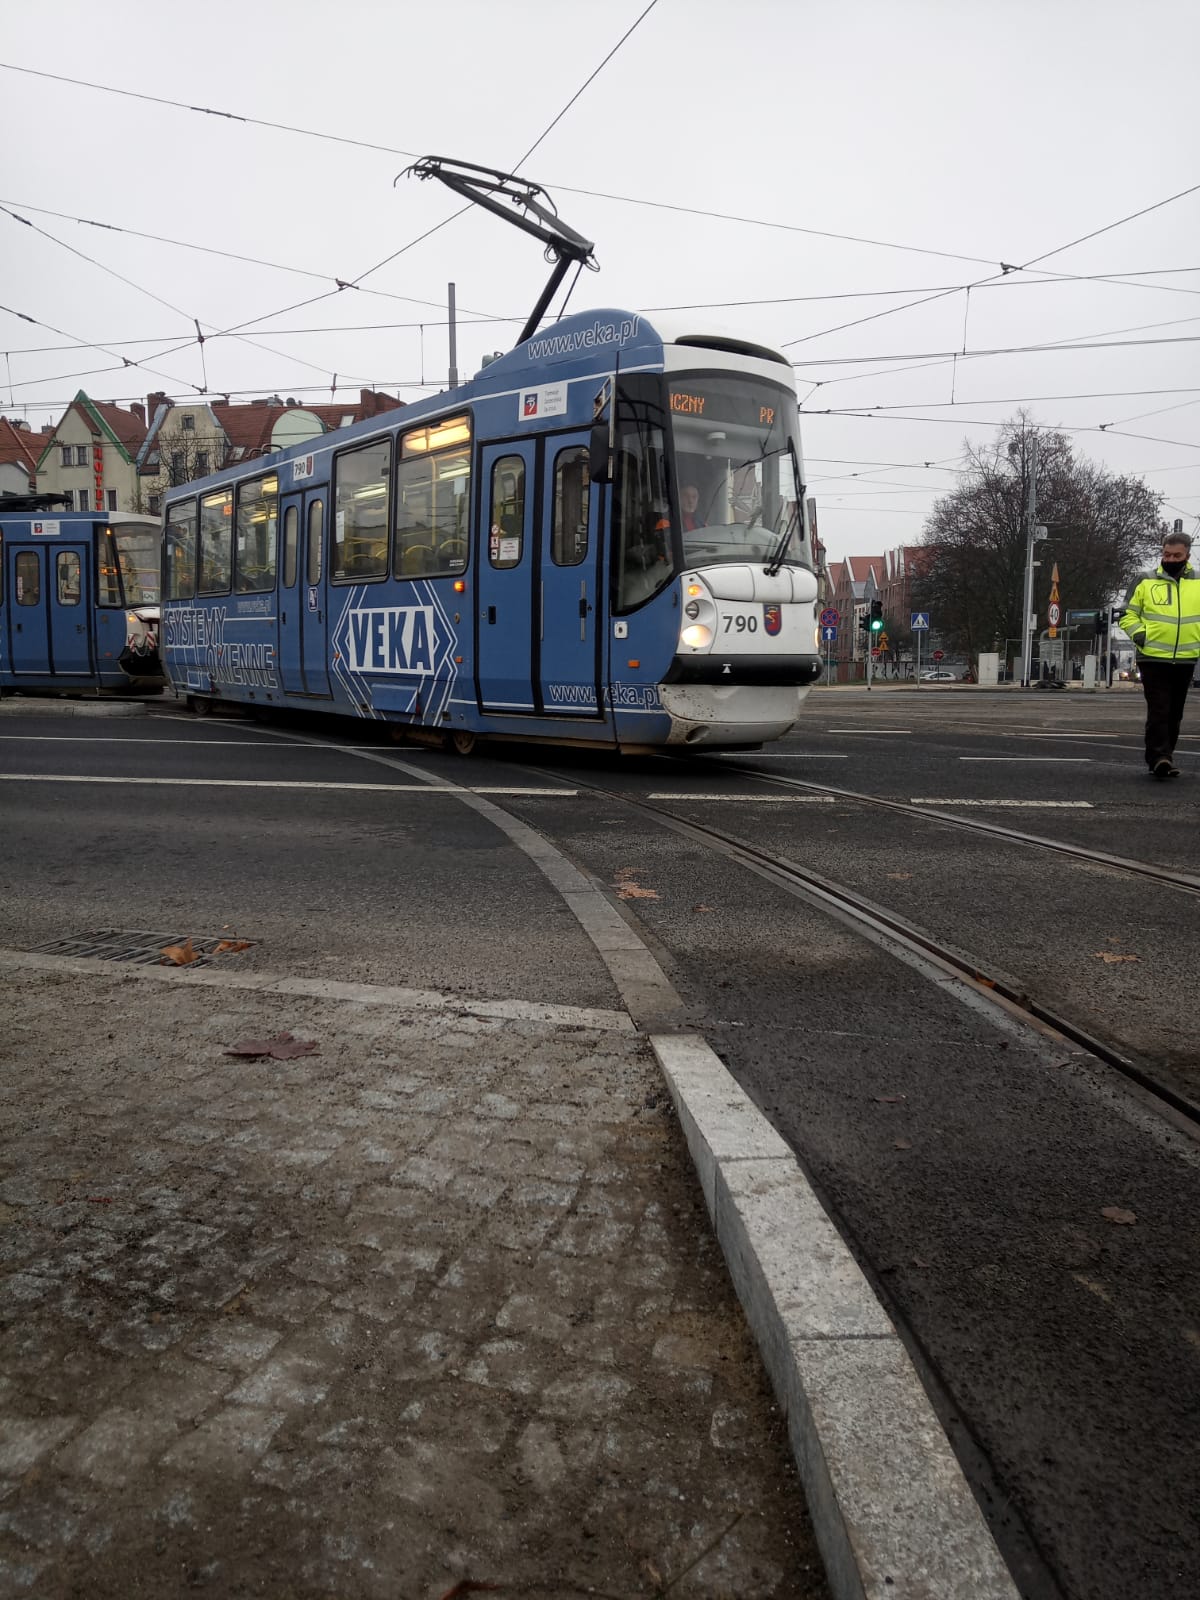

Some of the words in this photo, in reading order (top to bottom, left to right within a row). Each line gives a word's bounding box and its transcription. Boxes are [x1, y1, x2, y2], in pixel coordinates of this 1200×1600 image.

[528, 315, 640, 359] www.veka.pl
[760, 406, 774, 424] PR
[294, 461, 306, 476] 790
[165, 606, 227, 647] SYSTEMY
[722, 615, 758, 634] 790
[1050, 607, 1059, 621] 40
[351, 610, 432, 671] VEKA
[206, 643, 278, 689] OKIENNE
